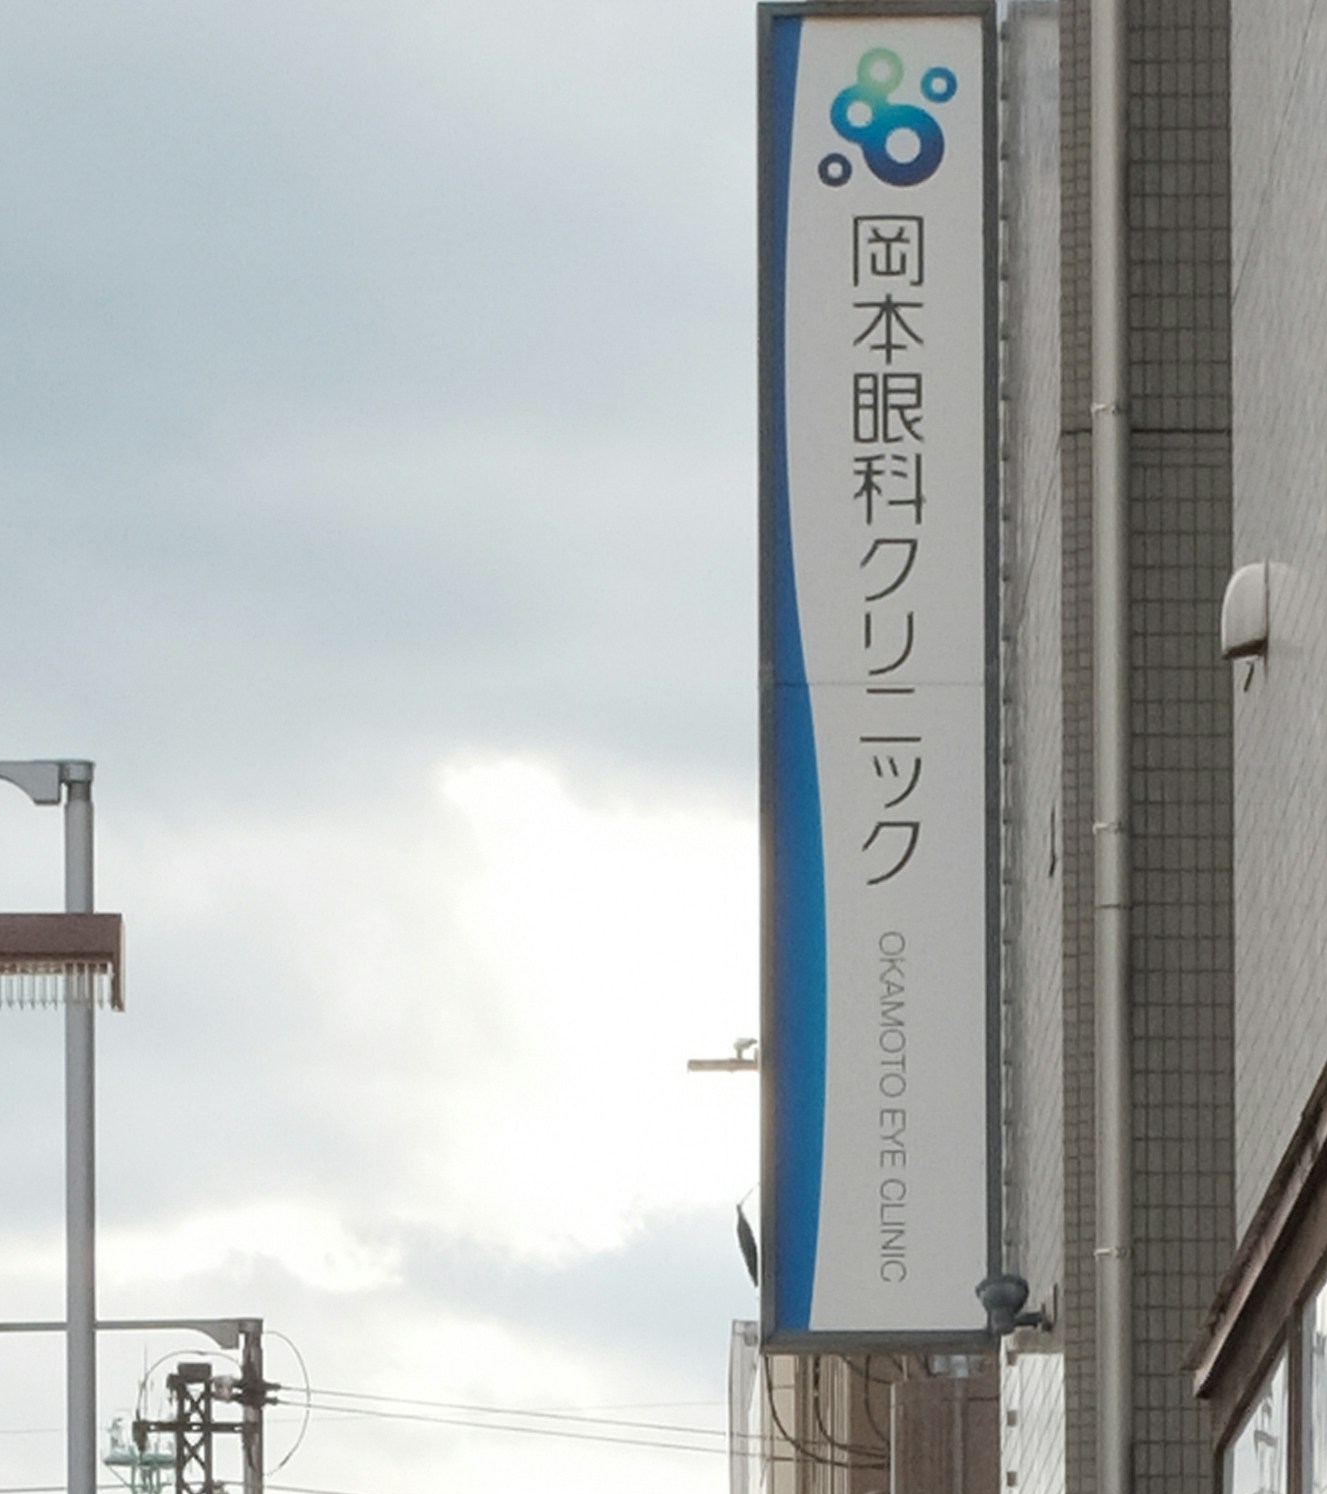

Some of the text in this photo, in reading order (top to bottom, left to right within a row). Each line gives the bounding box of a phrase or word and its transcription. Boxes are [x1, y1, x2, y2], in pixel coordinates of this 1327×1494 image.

[852, 215, 926, 886] 岡本眼科クリニック
[878, 930, 908, 1284] OKAMOTO EYE CLINIC
